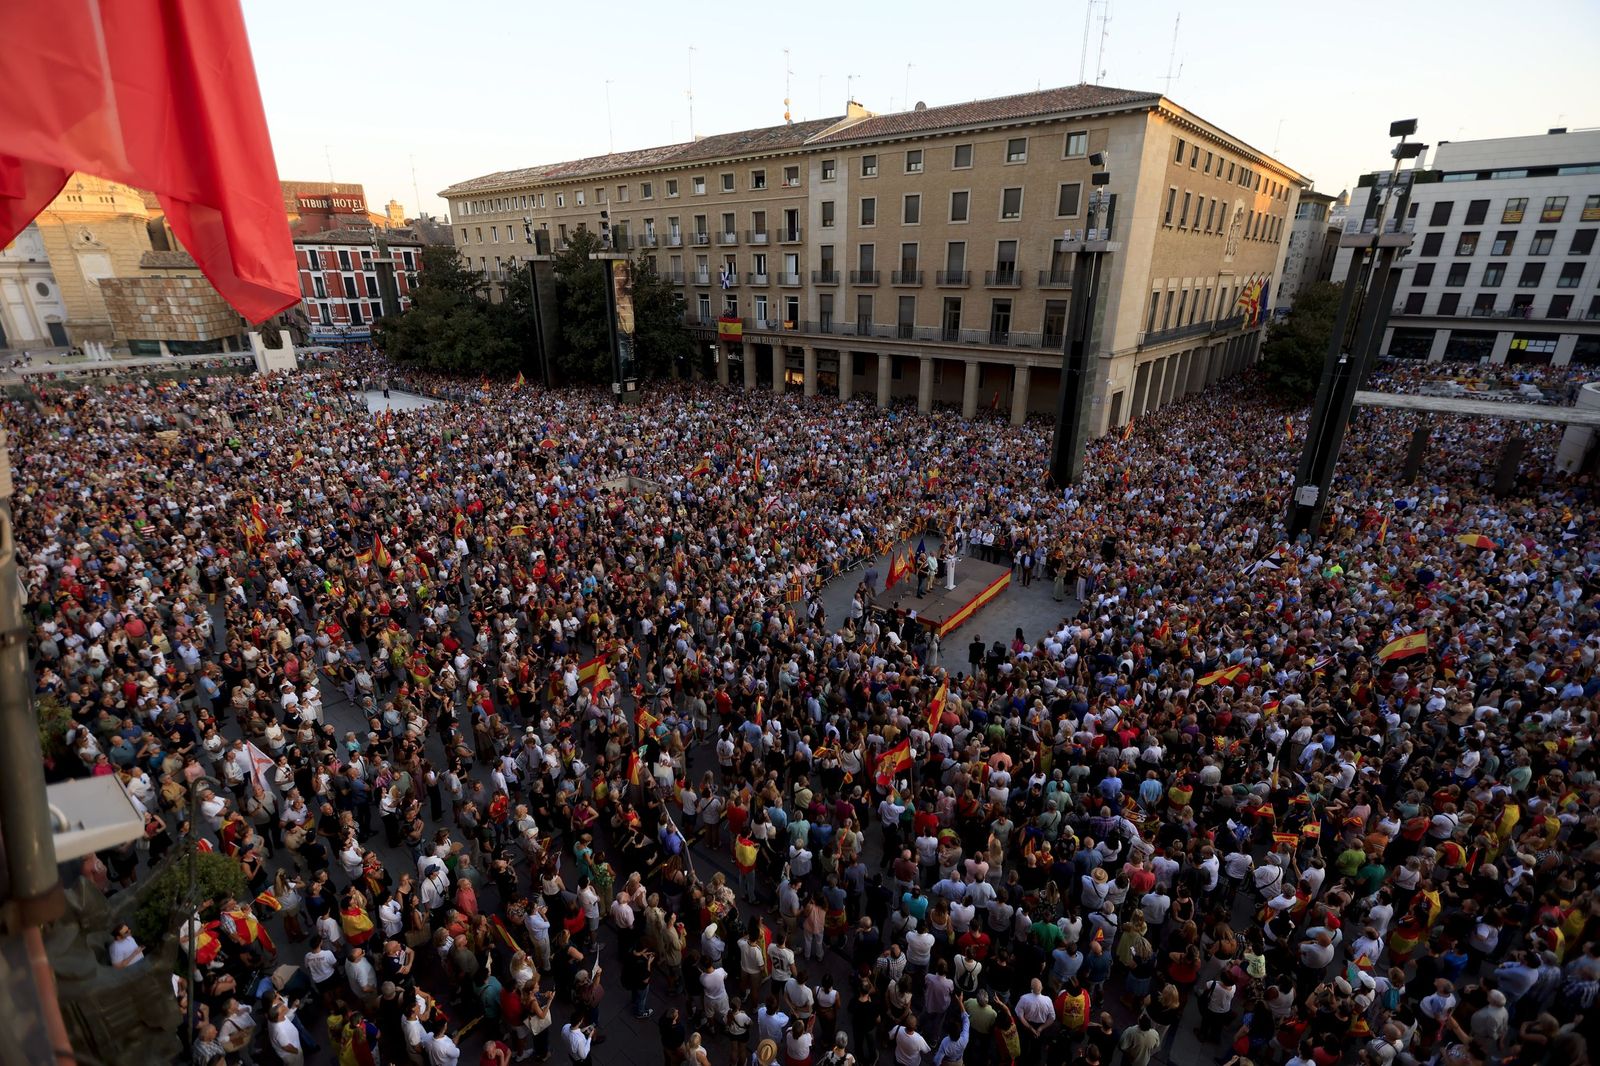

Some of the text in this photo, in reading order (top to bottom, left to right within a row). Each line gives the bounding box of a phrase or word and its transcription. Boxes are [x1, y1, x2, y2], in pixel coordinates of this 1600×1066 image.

[300, 199, 364, 208] TIBUR HOTEL
[773, 957, 785, 971] 21
